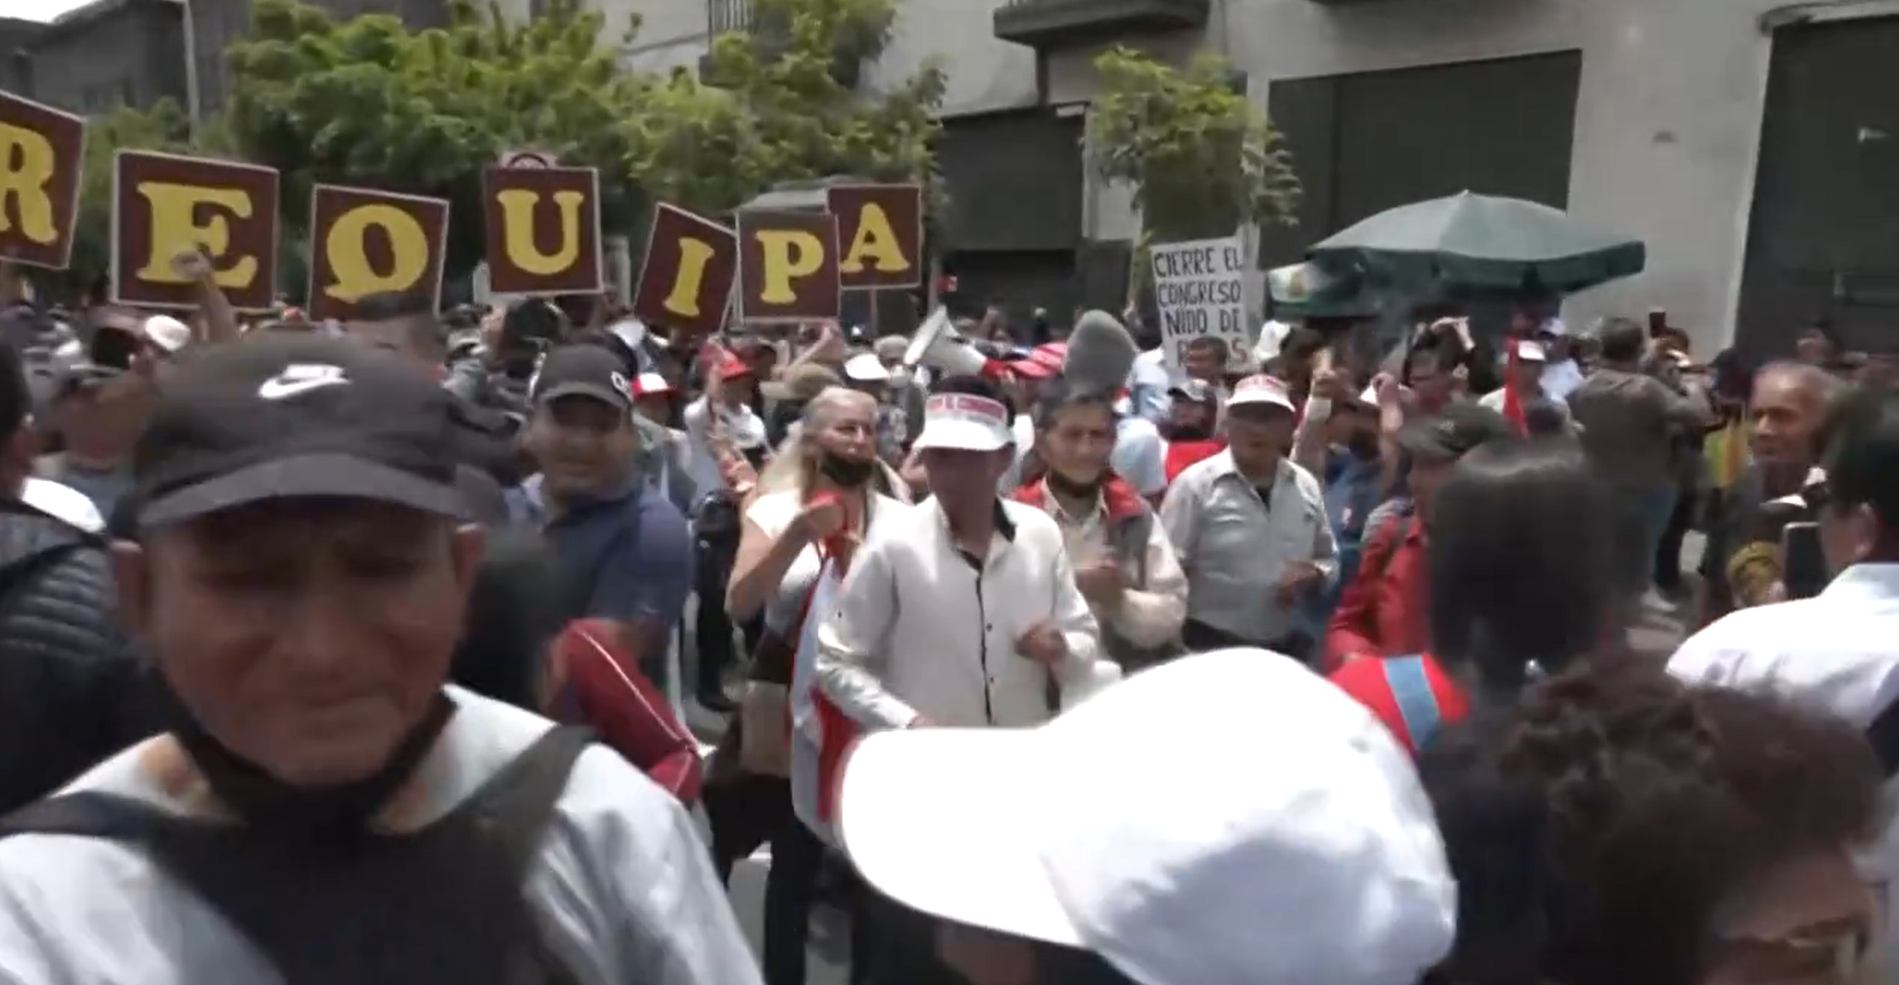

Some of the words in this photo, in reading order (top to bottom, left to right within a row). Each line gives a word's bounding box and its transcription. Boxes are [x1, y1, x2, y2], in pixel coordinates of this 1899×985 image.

[1154, 247, 1216, 278] CIERRE
[1224, 246, 1242, 272] EL
[1158, 279, 1241, 308] CONGRESO
[1165, 307, 1207, 337] NIDO
[1220, 307, 1241, 333] DE
